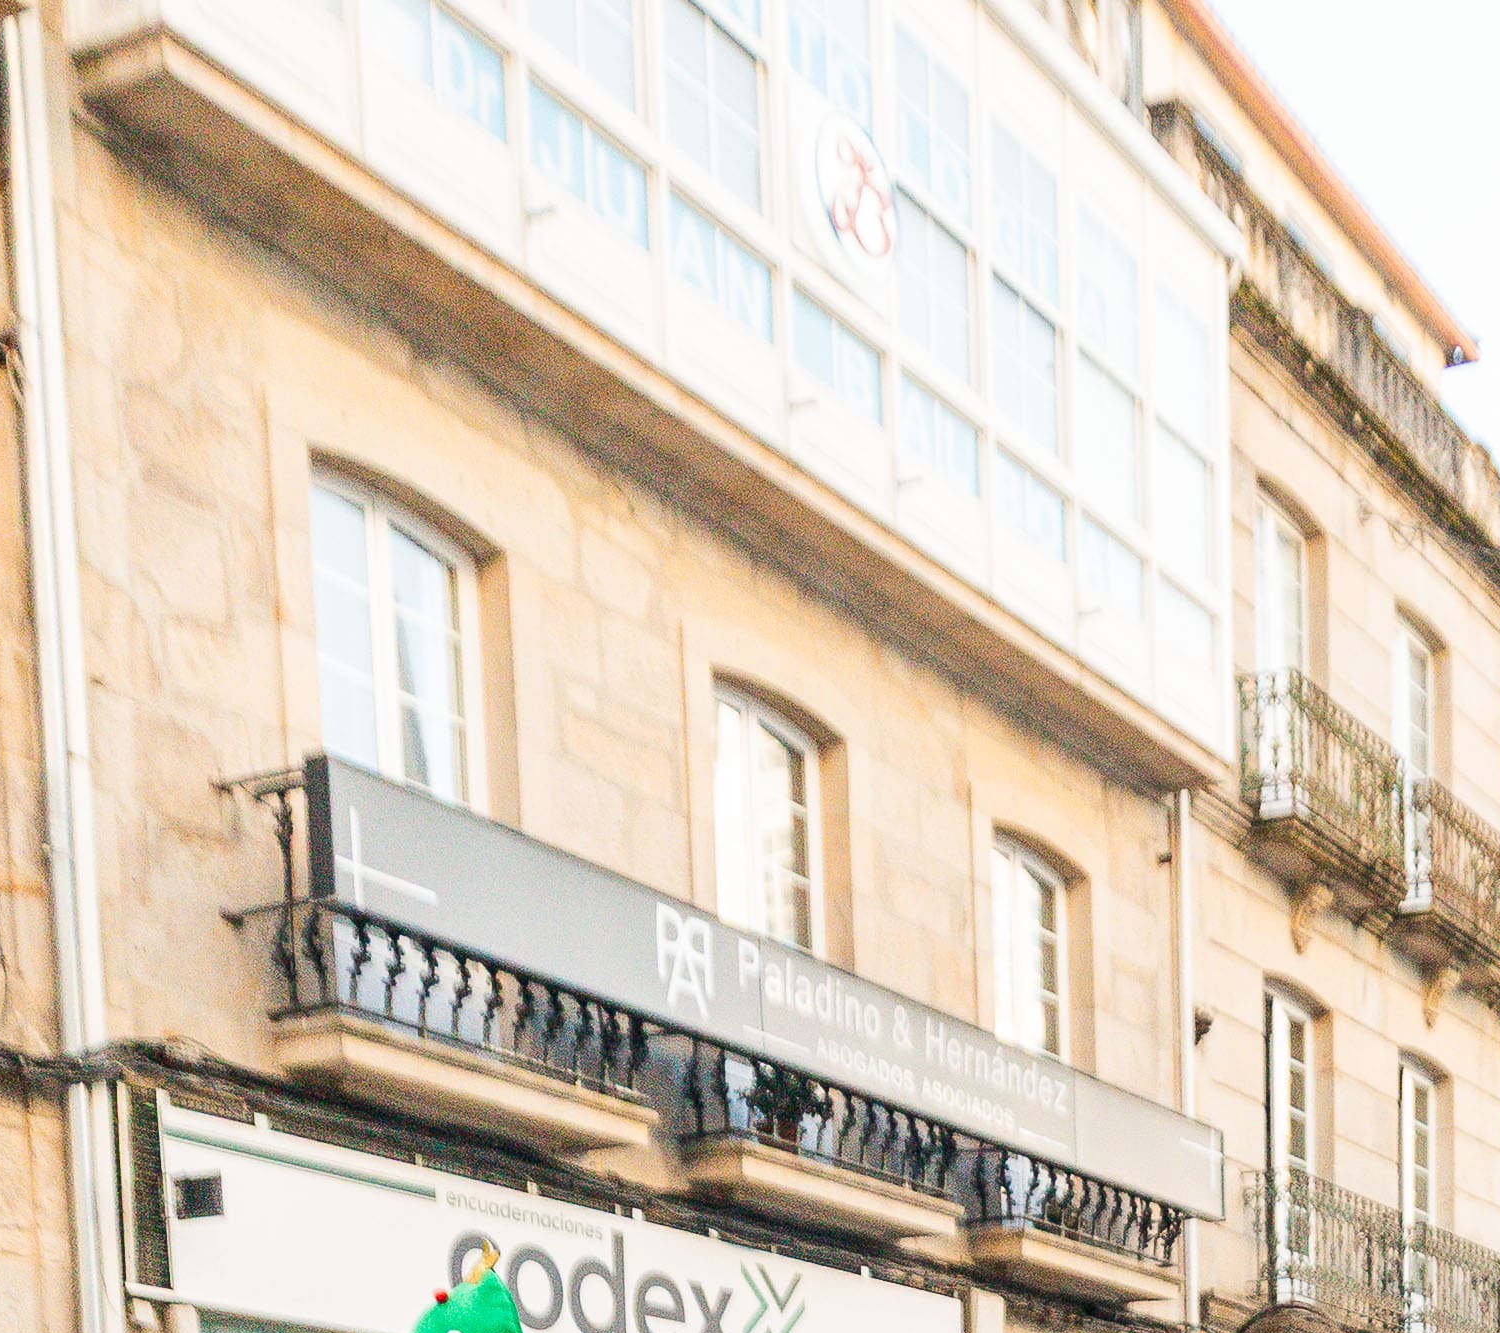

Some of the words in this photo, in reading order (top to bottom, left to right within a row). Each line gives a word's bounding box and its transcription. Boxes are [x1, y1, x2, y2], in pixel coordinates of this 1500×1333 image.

[535, 112, 766, 336] JUAN
[738, 937, 881, 1035] Paladino
[892, 1004, 916, 1050] &
[815, 1036, 915, 1094] ABOGADOS
[921, 1077, 1016, 1130] ASOCIADOS
[445, 1191, 604, 1241] encuadernaciones
